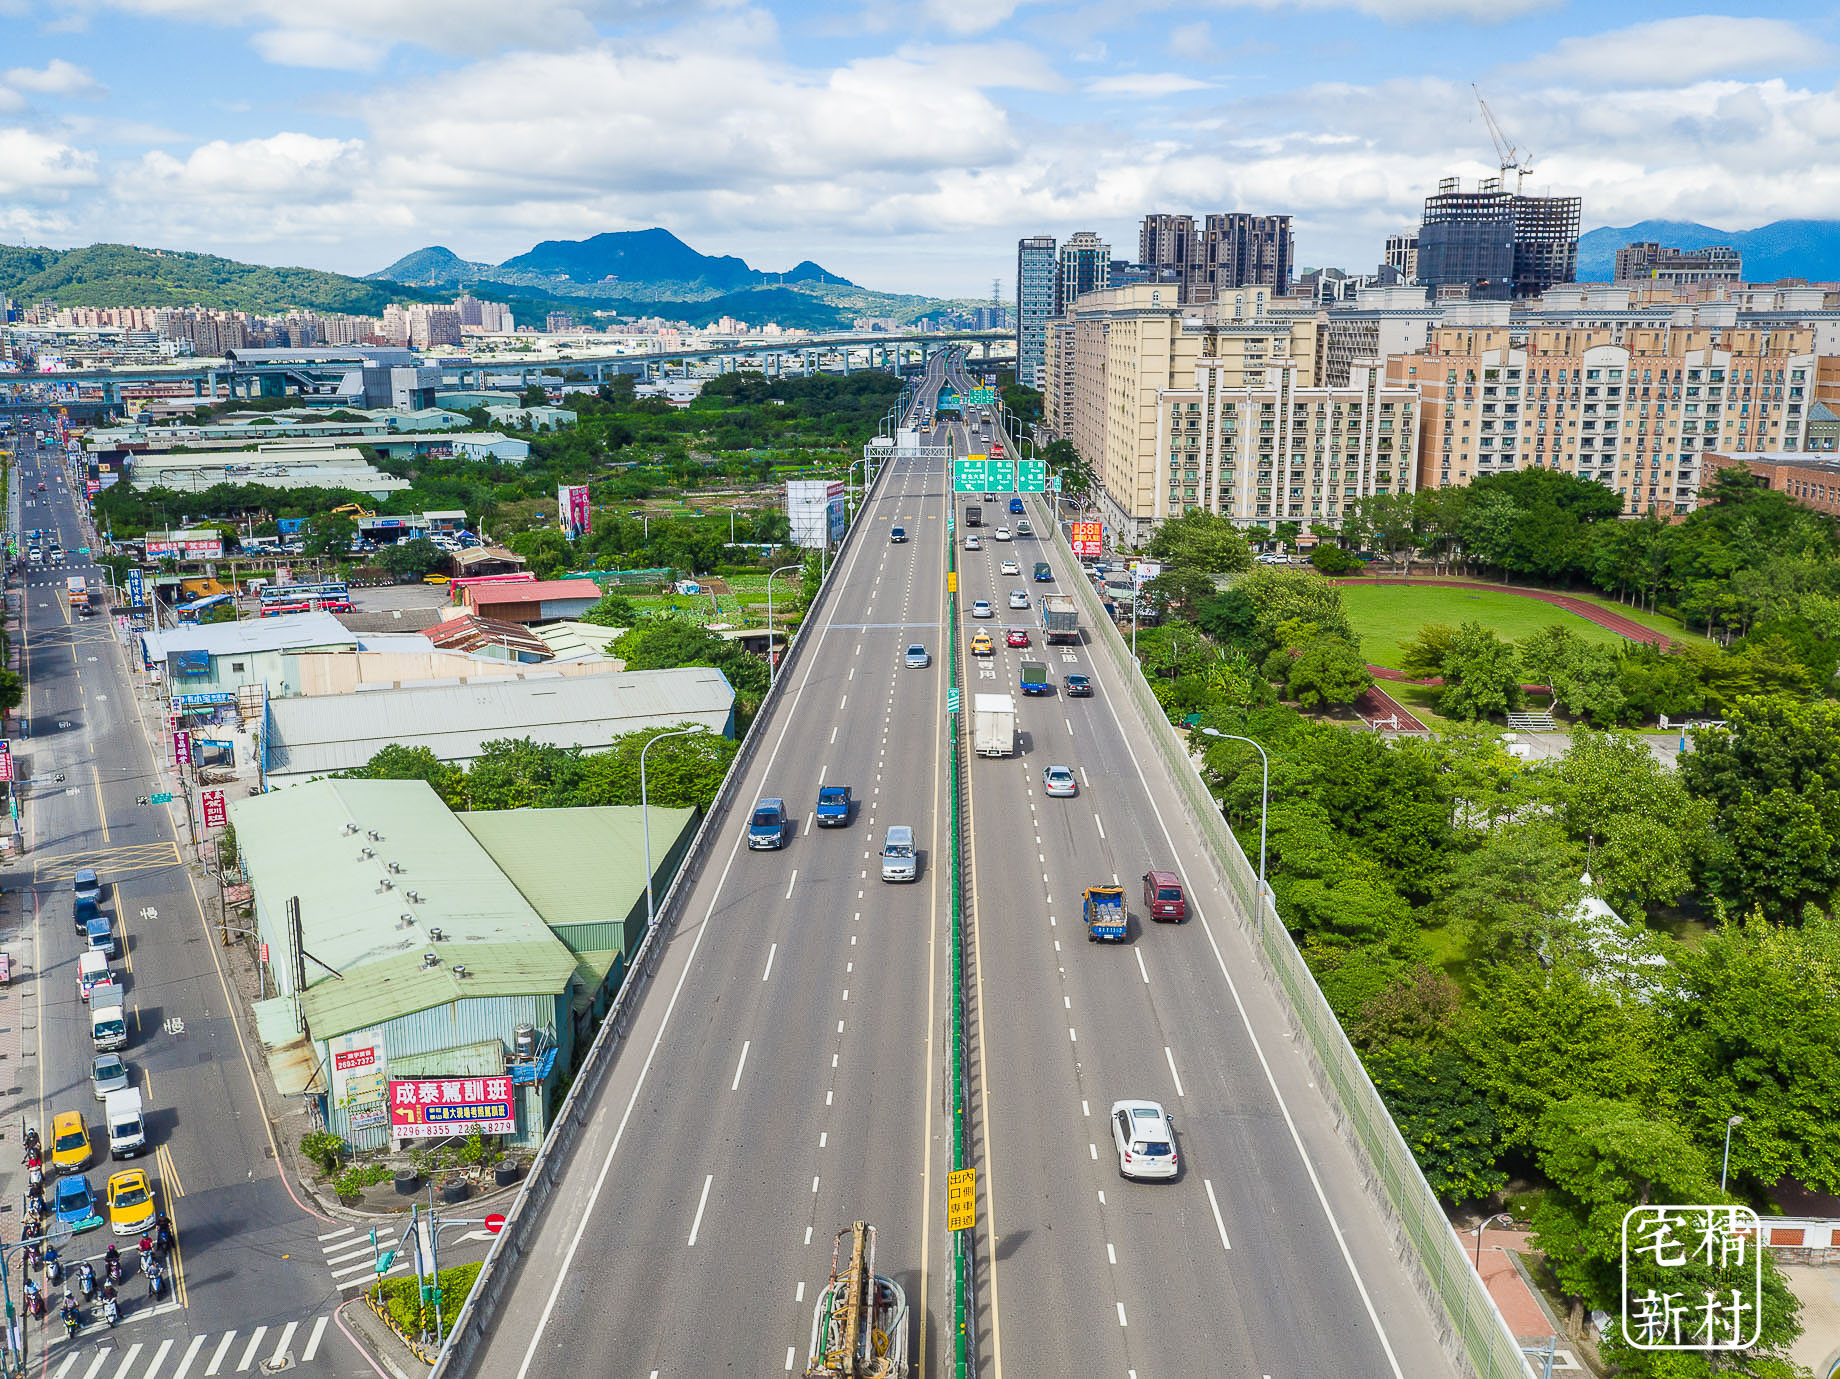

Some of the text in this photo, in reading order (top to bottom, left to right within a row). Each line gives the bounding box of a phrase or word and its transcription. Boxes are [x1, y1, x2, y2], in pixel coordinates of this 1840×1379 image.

[163, 1017, 185, 1035] 慢
[396, 1079, 508, 1104] 成泰駕訓班
[397, 1125, 450, 1137] 2296-8355
